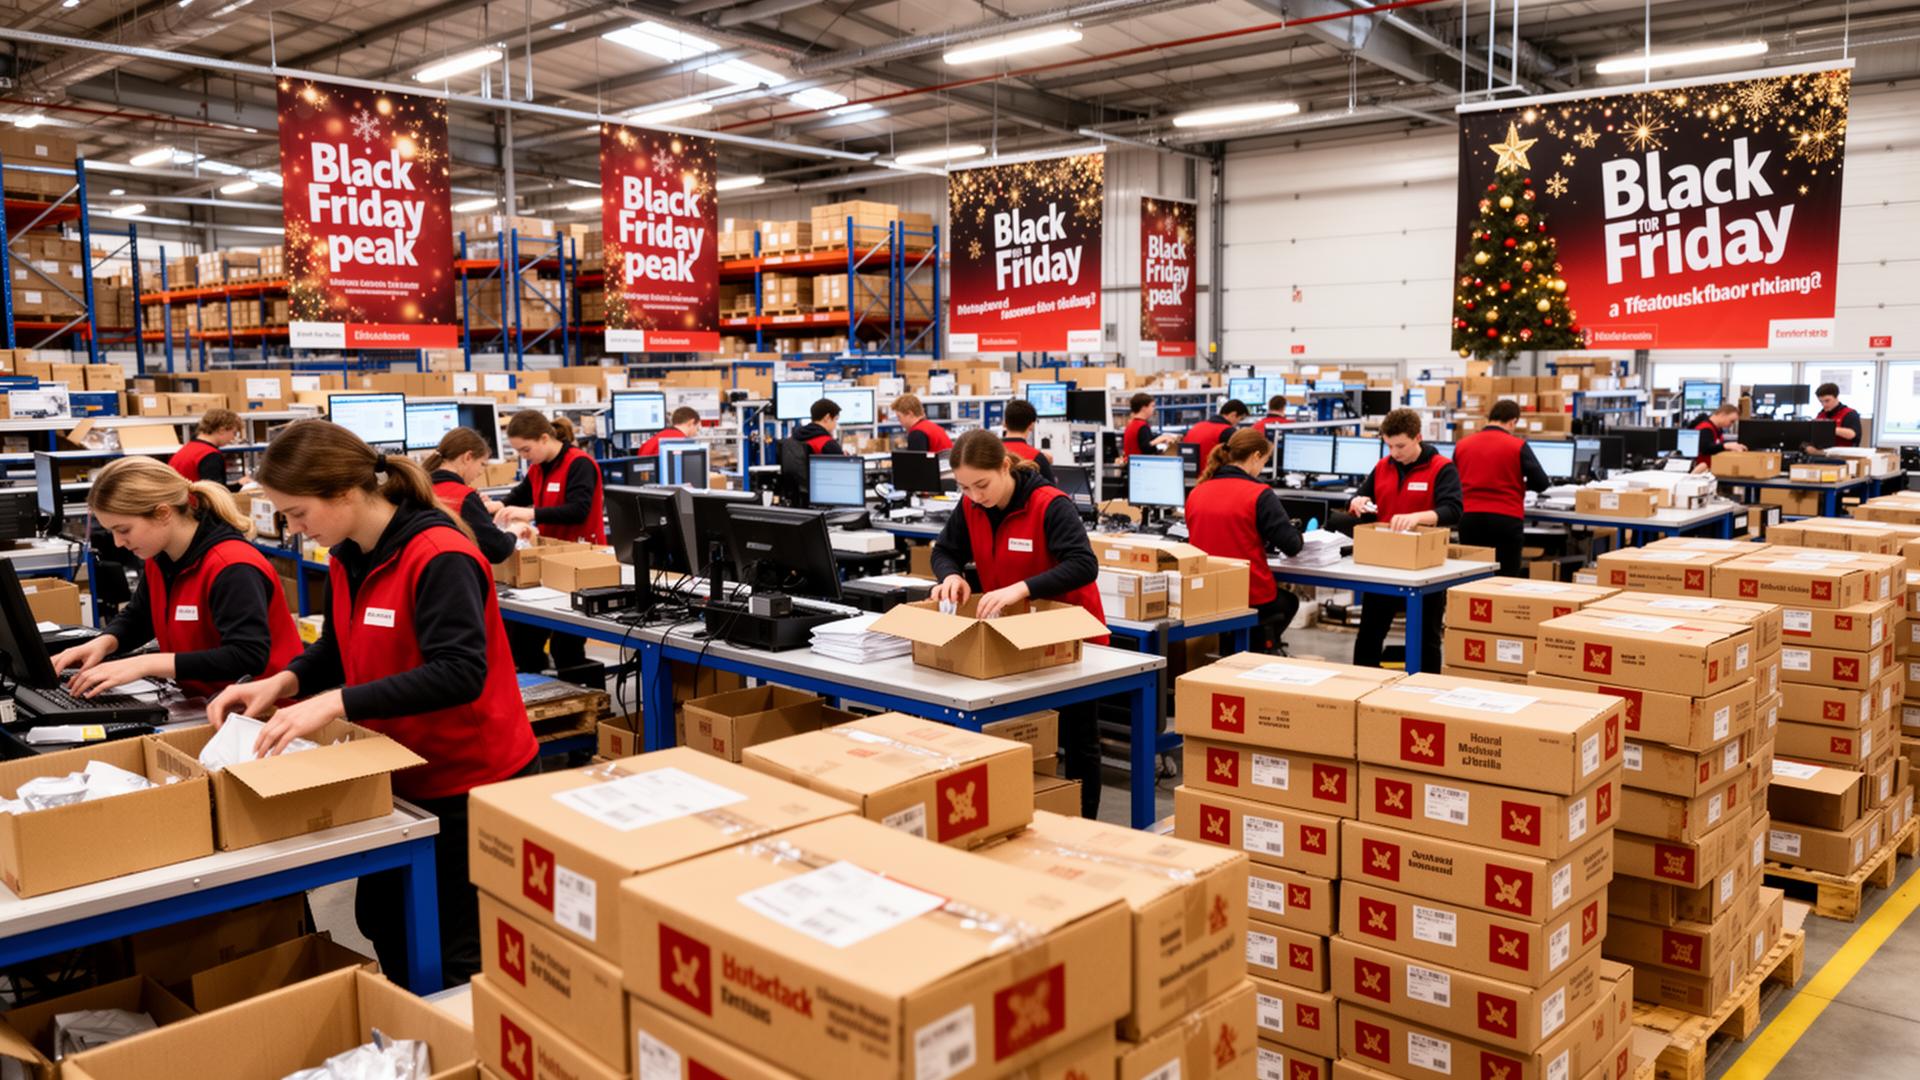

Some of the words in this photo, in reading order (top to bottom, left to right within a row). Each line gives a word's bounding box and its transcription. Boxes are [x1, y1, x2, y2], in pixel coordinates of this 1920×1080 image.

[310, 142, 415, 191] Black
[1601, 137, 1774, 220] Black
[308, 182, 425, 239] Friday
[622, 176, 701, 218] Black
[619, 209, 705, 261] Friday
[994, 202, 1067, 248] Black
[1148, 235, 1187, 261] Black
[1604, 204, 1795, 285] Friday
[328, 229, 419, 272] peak
[625, 250, 696, 284] peak
[995, 244, 1083, 291] Friday
[1146, 258, 1189, 293] Friday
[1149, 283, 1183, 311] peak
